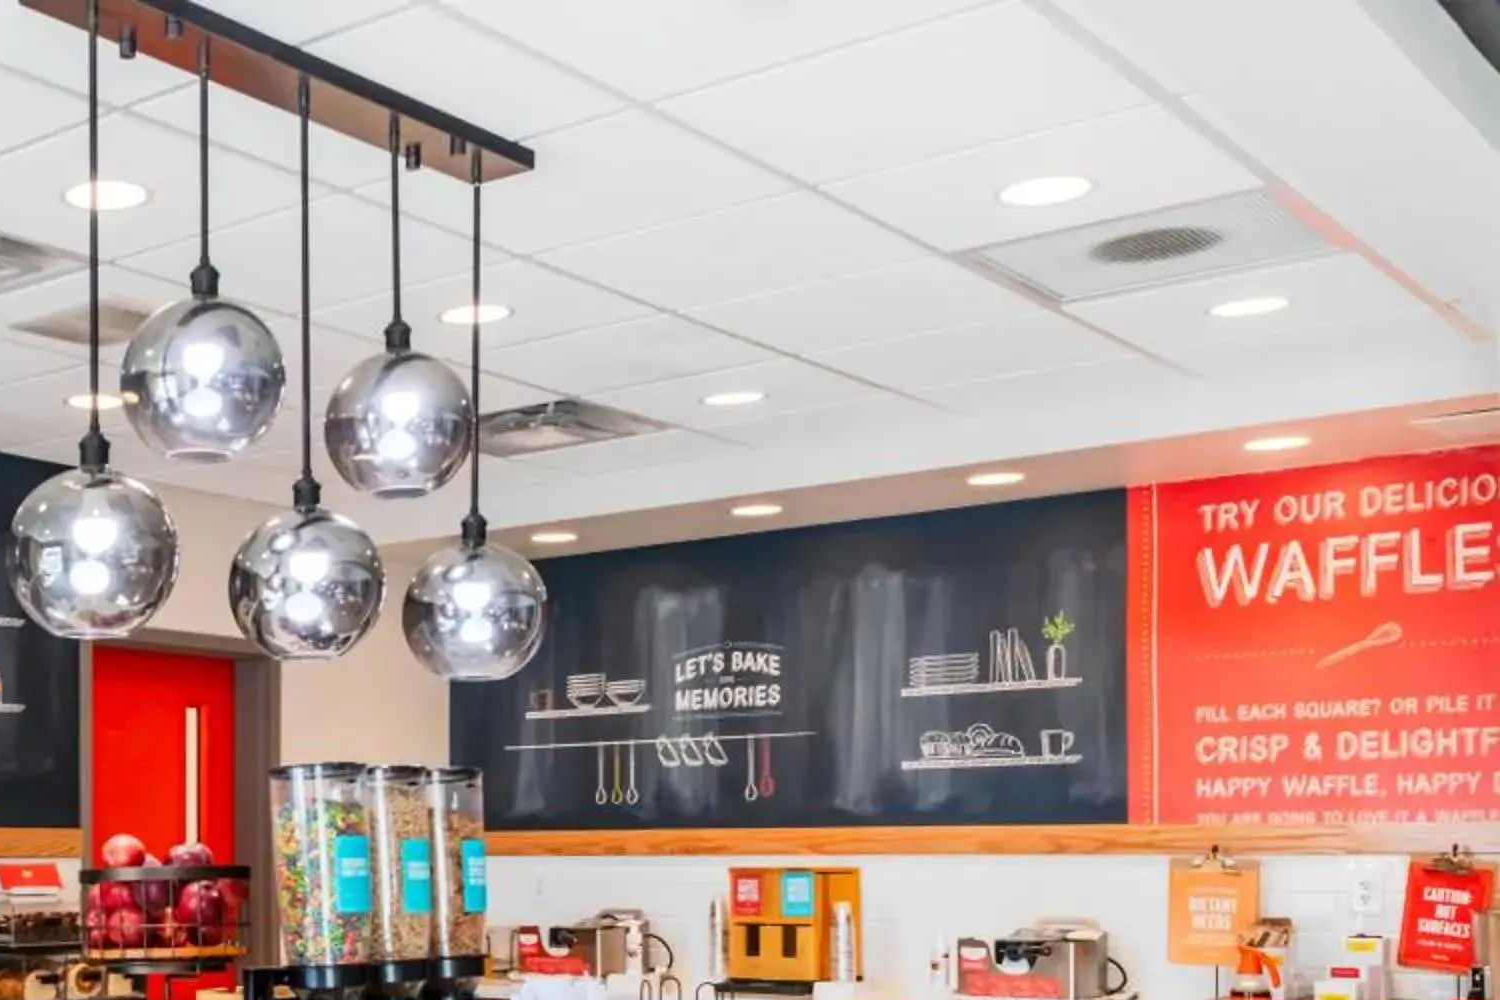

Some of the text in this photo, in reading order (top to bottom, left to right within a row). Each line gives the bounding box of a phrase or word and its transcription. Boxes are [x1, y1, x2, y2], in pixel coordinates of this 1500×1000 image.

[1199, 473, 1500, 533] TRY OUR DELICIO
[1197, 521, 1500, 608] WAFFLE
[674, 651, 781, 684] LET'S BAKE
[674, 684, 781, 711] MEMORIES
[1195, 693, 1498, 723] FILL EACH SQUARE? OR PILE IT
[1195, 726, 1500, 764] CRISP & DELIGHTF
[1195, 777, 1272, 798] HAPPY
[1282, 773, 1388, 798] WAFFLE,
[1397, 771, 1483, 796] HAPPY
[1417, 918, 1471, 939] SURFACES
